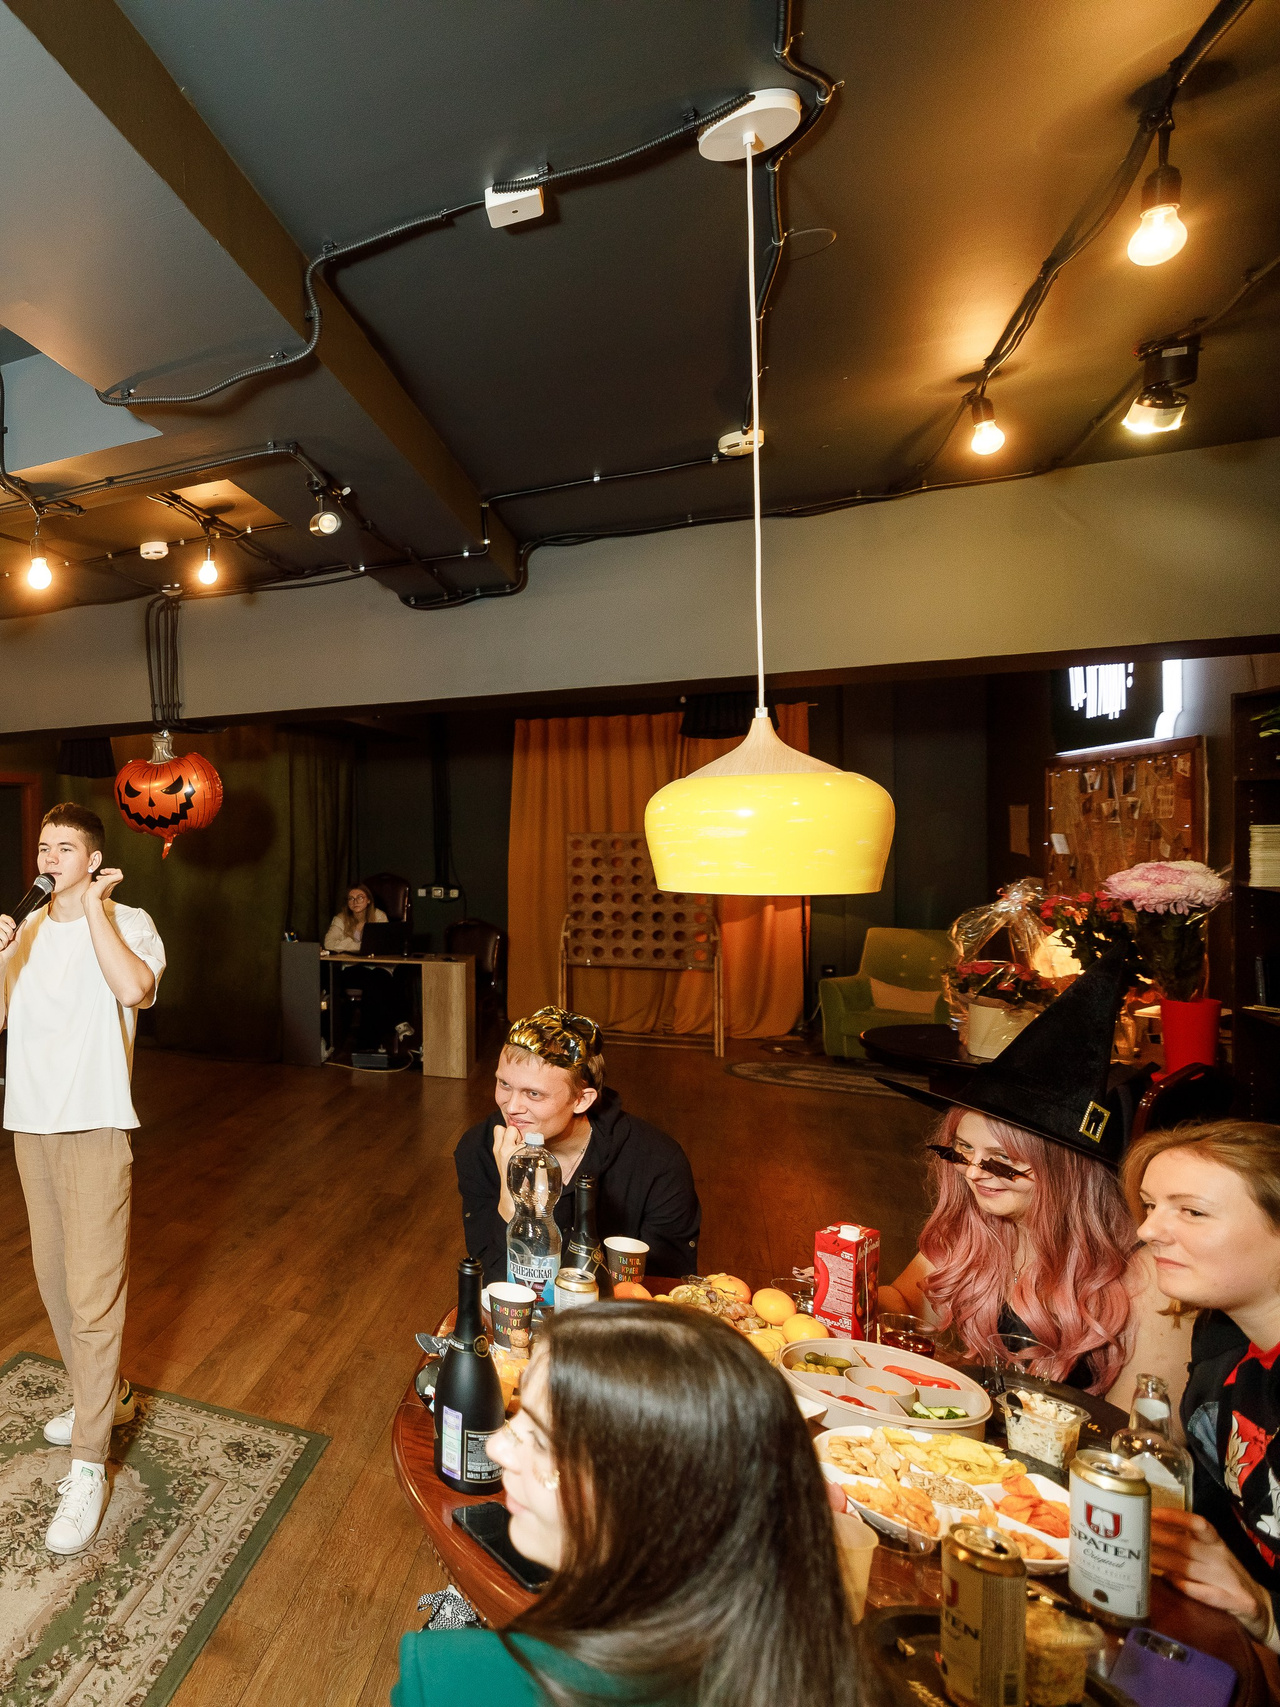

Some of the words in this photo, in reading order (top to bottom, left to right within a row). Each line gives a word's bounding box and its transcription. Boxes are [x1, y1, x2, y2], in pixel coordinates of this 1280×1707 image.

[618, 1255, 628, 1265] ТЫ
[510, 1262, 552, 1278] СЕНЕЖСКАЯ
[509, 1318, 522, 1327] ТОТ
[1071, 1524, 1140, 1560] SPATEN
